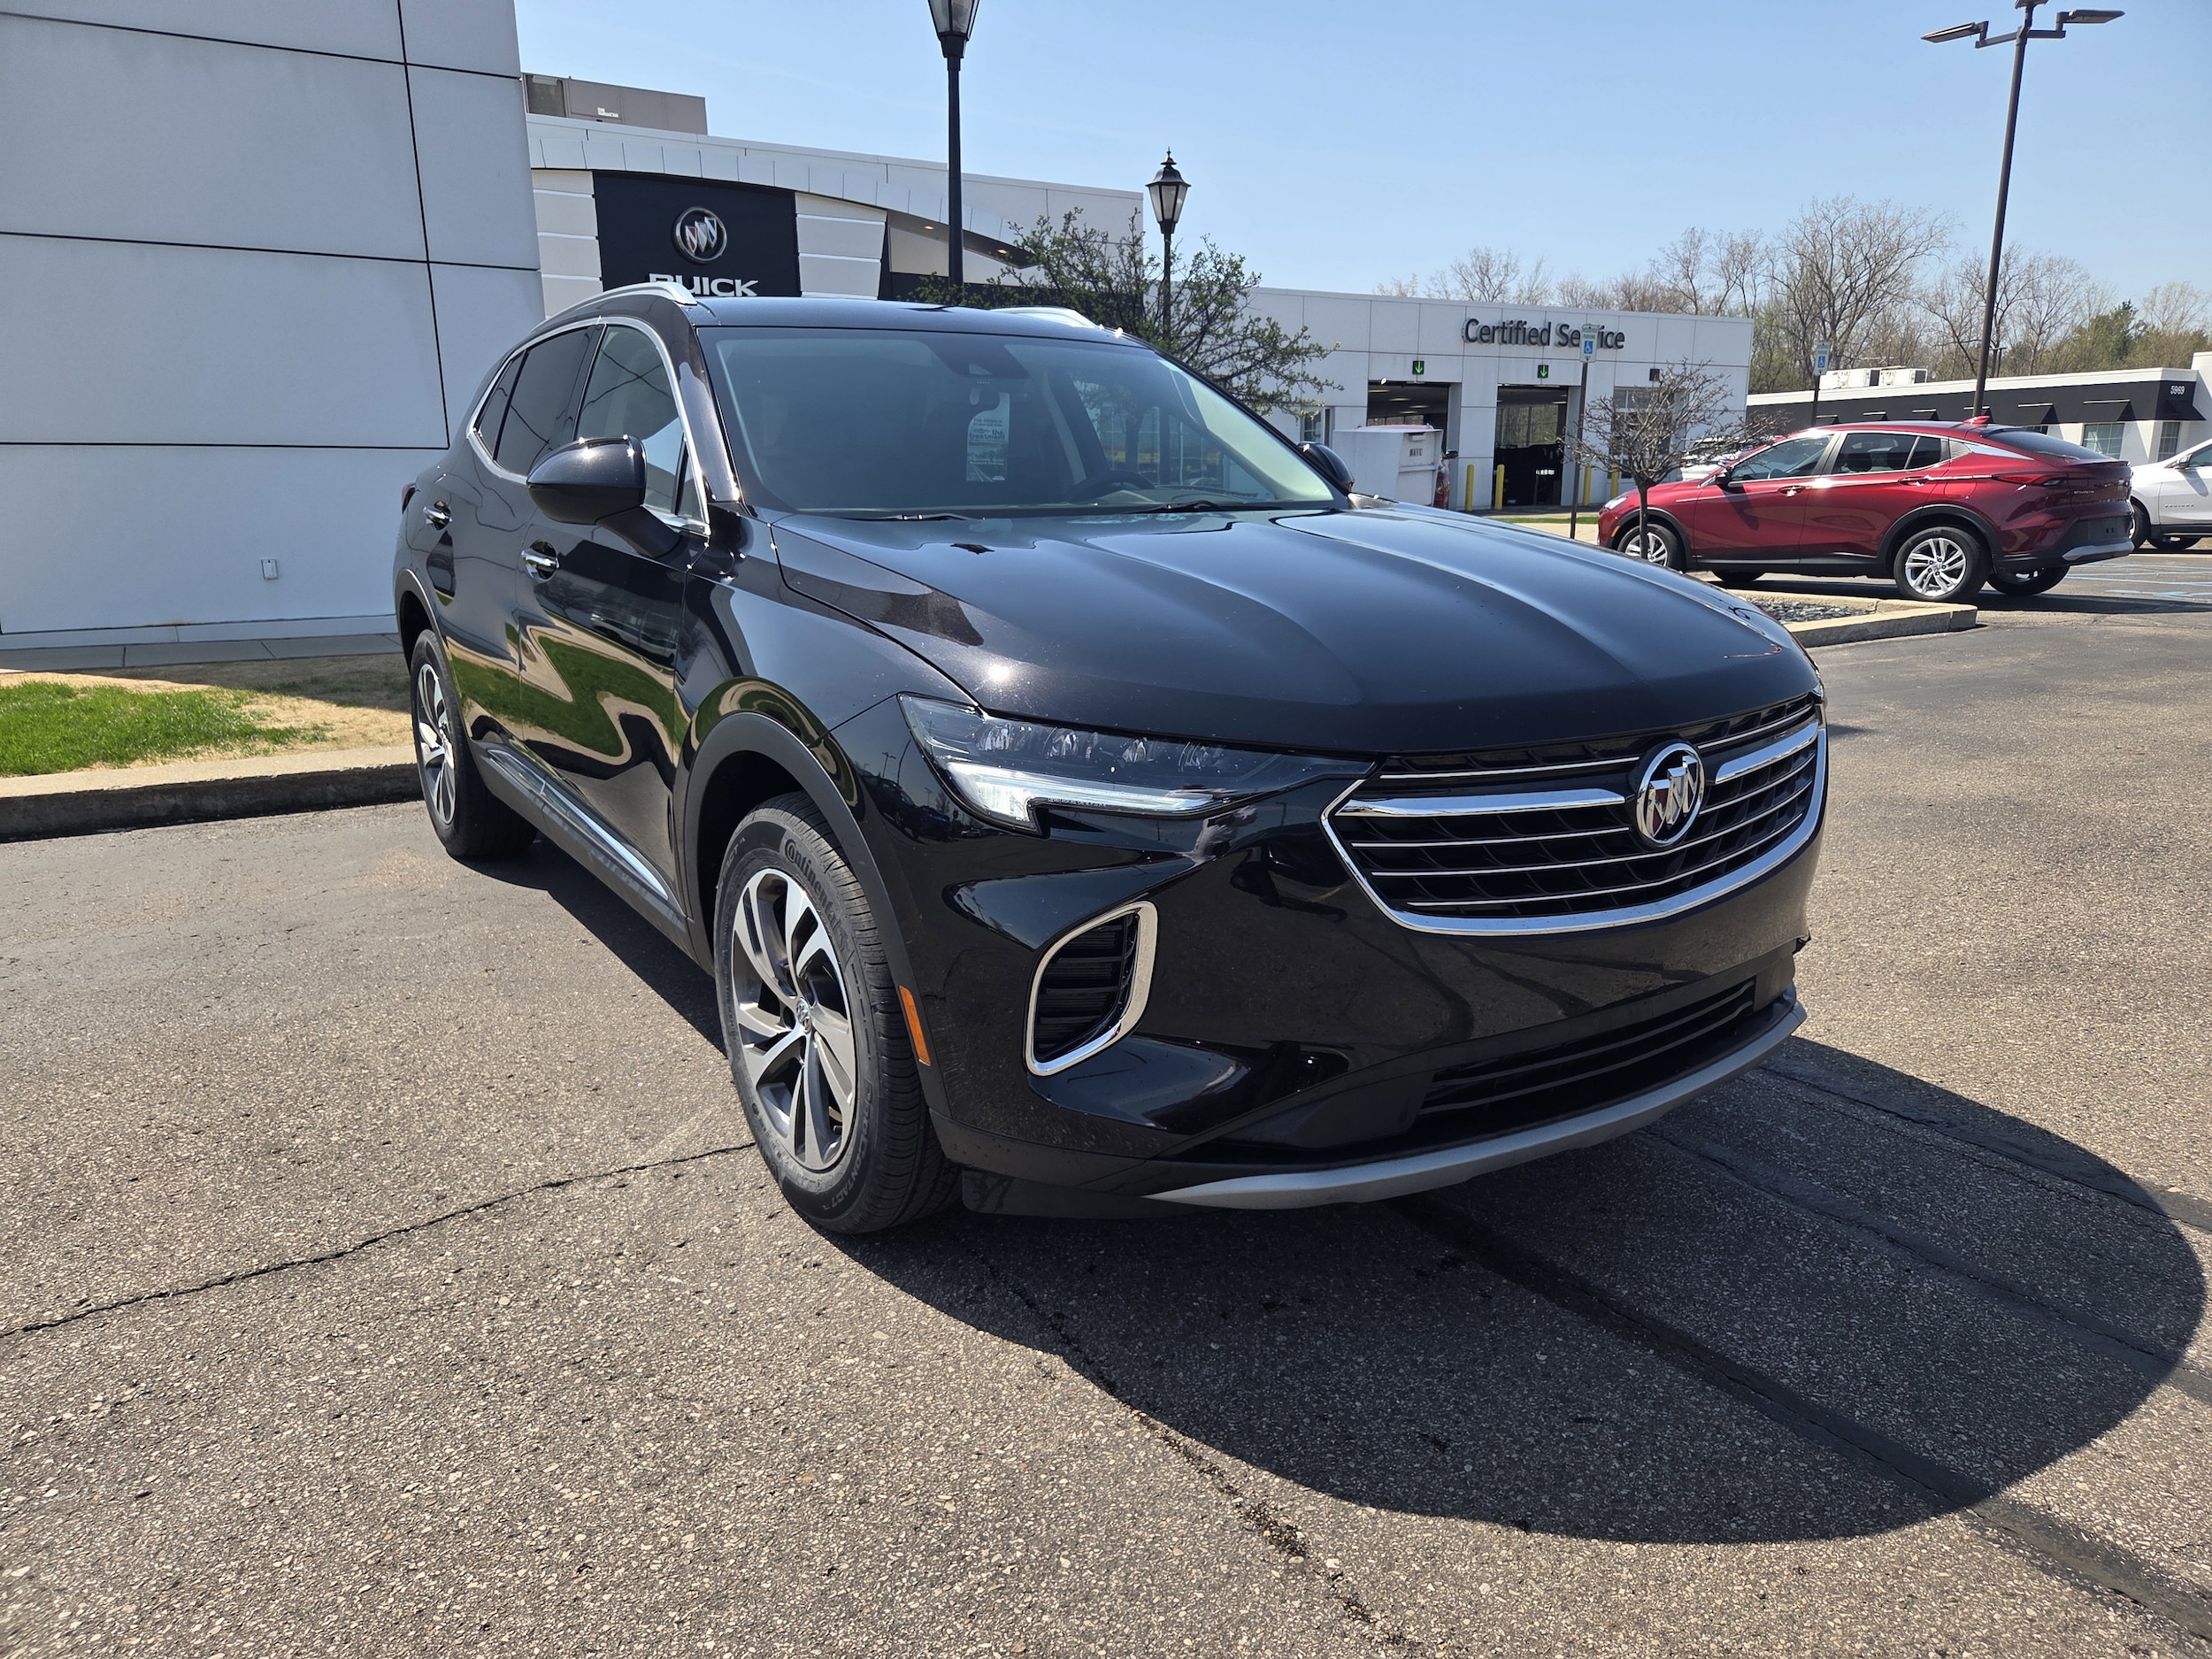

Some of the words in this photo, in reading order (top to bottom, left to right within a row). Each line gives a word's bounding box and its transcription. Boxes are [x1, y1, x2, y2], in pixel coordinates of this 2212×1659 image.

[1463, 318, 1551, 346] Certified
[1556, 323, 1625, 349] Seice
[784, 838, 842, 932] Continental
